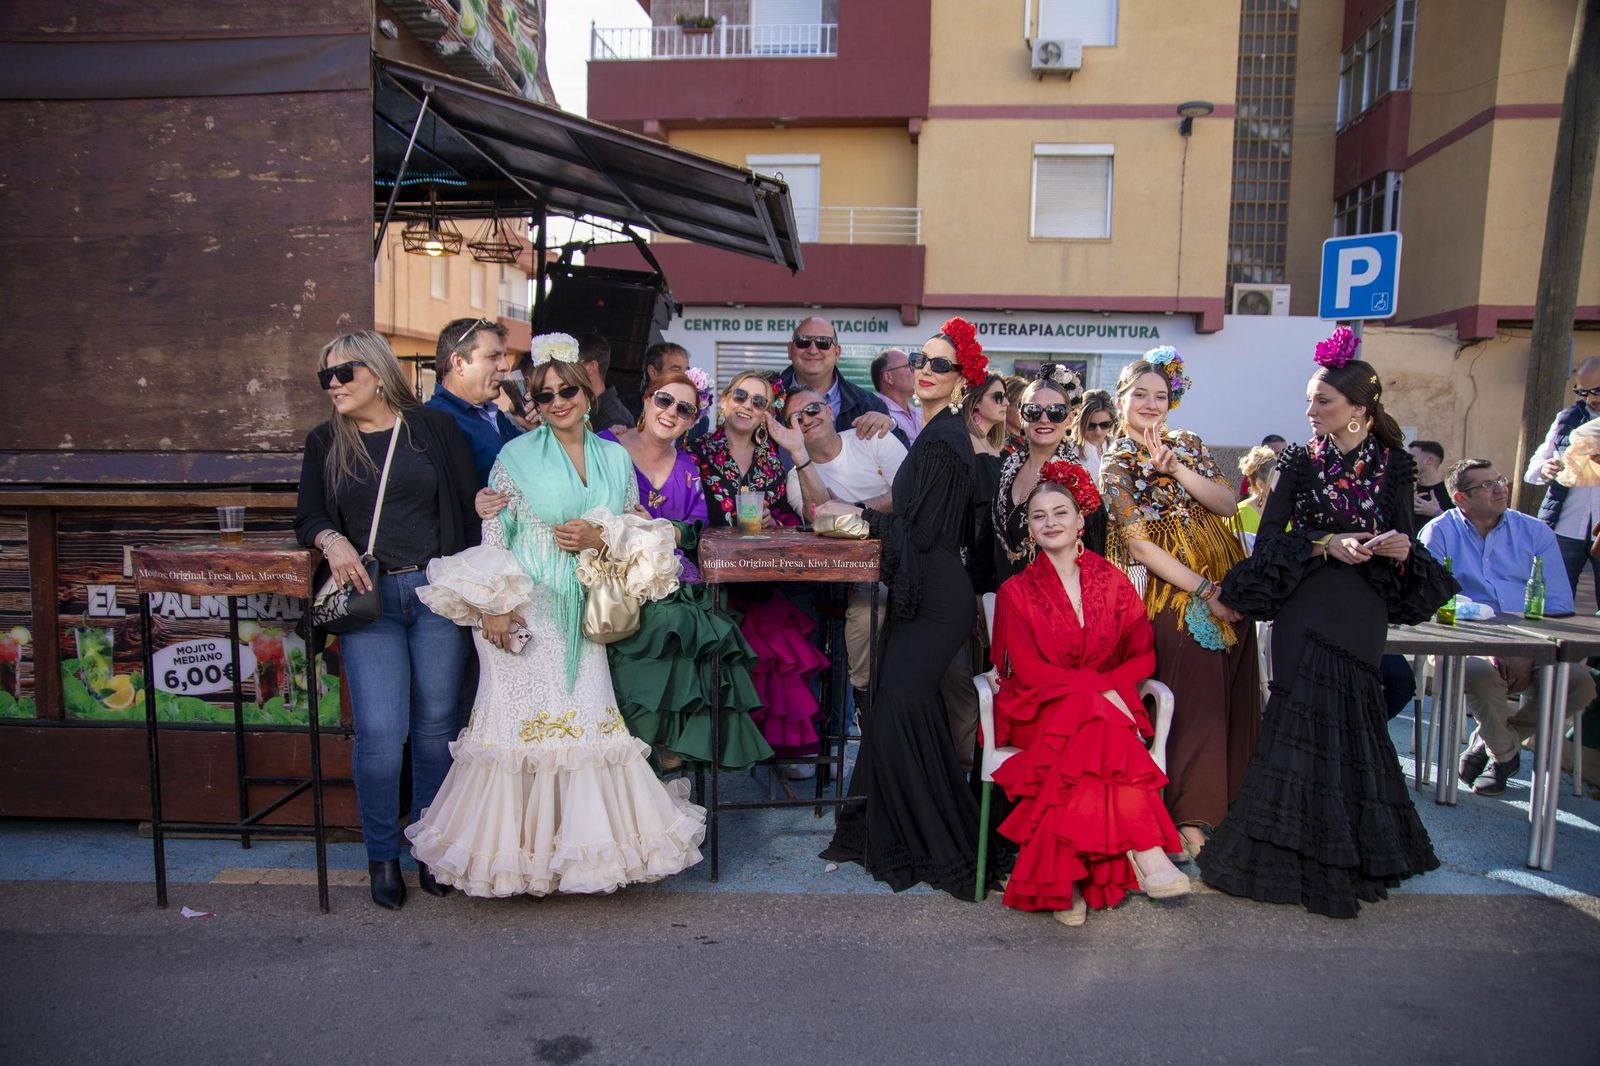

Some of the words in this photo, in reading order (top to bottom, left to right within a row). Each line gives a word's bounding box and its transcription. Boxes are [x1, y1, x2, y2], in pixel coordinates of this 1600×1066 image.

[1335, 246, 1382, 309] P
[684, 319, 740, 331] CENTRO
[745, 319, 763, 332] DE
[87, 585, 126, 617] EL
[173, 652, 223, 666] MEDIANO
[176, 643, 216, 656] MOJITO
[164, 662, 234, 692] 6,00€
